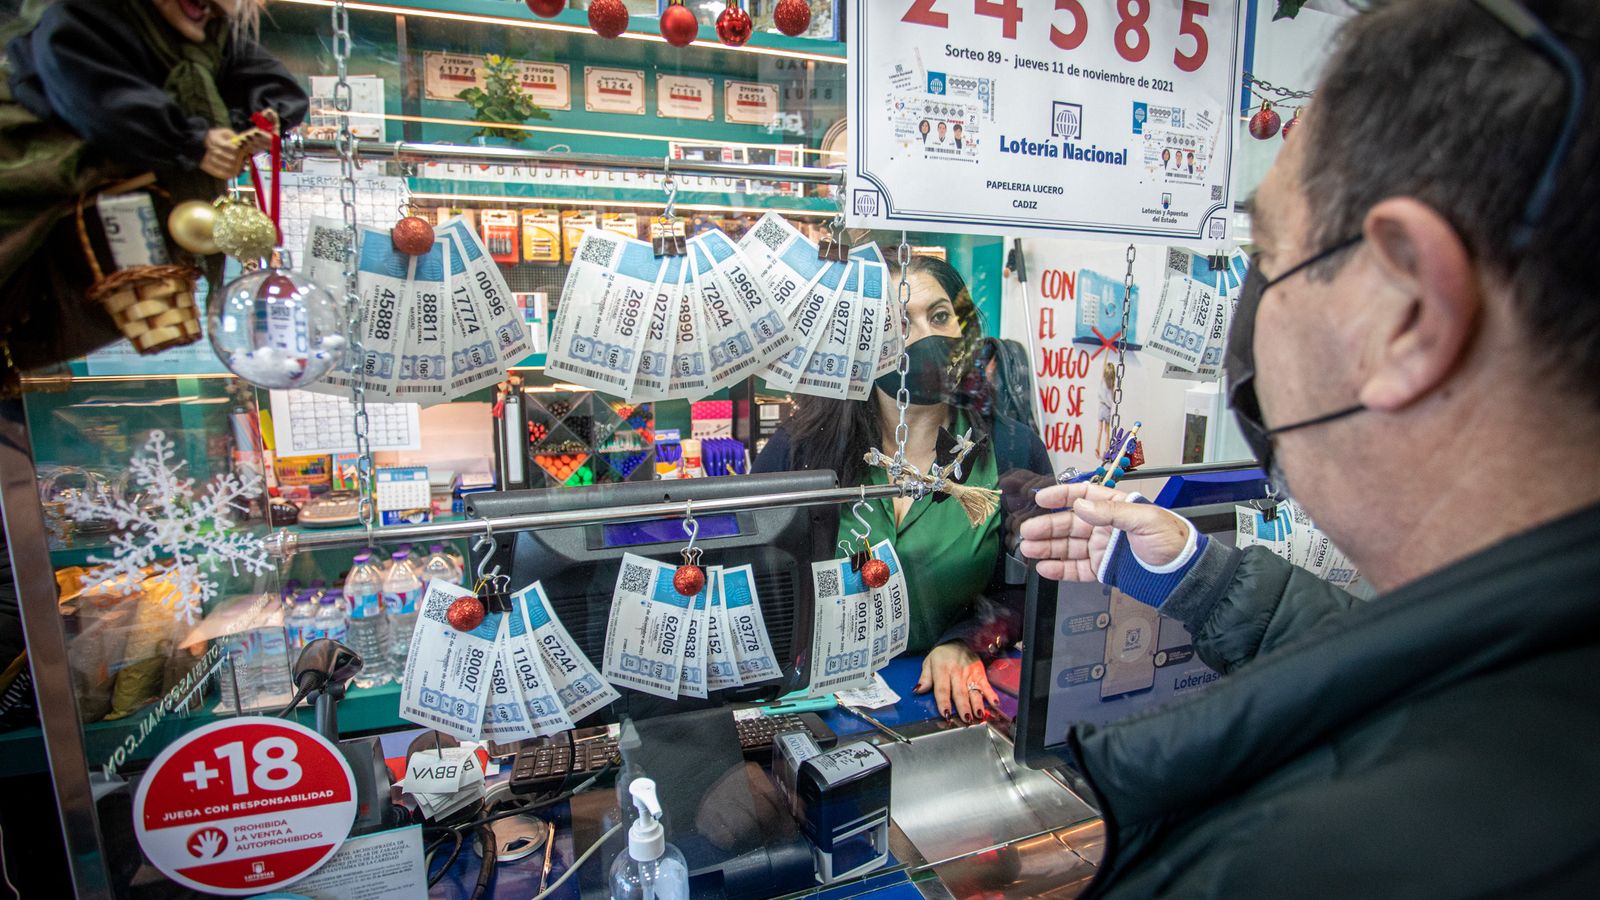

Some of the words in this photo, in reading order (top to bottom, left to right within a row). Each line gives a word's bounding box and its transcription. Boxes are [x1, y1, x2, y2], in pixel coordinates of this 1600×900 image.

[945, 44, 984, 62] Sorteo
[988, 50, 1001, 64] 89
[1014, 54, 1049, 72] jueves
[1052, 62, 1064, 74] 11
[1067, 64, 1080, 76] de
[1082, 68, 1134, 86] noviembre
[1138, 76, 1149, 88] de
[1152, 79, 1174, 92] 2021
[1000, 135, 1058, 158] Lotería
[1063, 142, 1127, 165] Nacional
[653, 172, 732, 187] LCERO
[986, 180, 1030, 192] PAPELERIA
[1033, 184, 1064, 194] LUCERO
[1012, 200, 1038, 209] CADIZ
[476, 270, 505, 316] 00696
[729, 265, 762, 309] 19662
[1041, 270, 1076, 301] CON
[375, 288, 396, 340] 45888
[422, 294, 437, 342] 88811
[453, 286, 480, 335] 17774
[621, 291, 644, 337] 26999
[650, 294, 668, 341] 02732
[704, 281, 733, 328] 72044
[799, 294, 824, 337] 90007
[835, 300, 850, 345] 08777
[1196, 292, 1211, 327] 42322
[1213, 304, 1223, 339] 04256
[859, 308, 874, 351] 24226
[1039, 308, 1055, 340] EL
[1037, 347, 1089, 379] JUEGO
[1067, 384, 1086, 417] SE
[1045, 422, 1083, 454] UEGA
[1316, 538, 1328, 568] 02908
[874, 593, 884, 630] 59992
[891, 584, 902, 620] 10030
[662, 616, 679, 656] 62005
[740, 615, 759, 652] 03778
[858, 602, 866, 641] 00164
[465, 648, 484, 693] 80007
[514, 647, 539, 690] 11043
[544, 634, 576, 672] 67244
[493, 653, 508, 694] 5580
[182, 736, 302, 796] +18
[412, 766, 457, 780] BBVA
[162, 809, 202, 821] JUEGA
[204, 805, 229, 816] CON
[232, 789, 334, 811] RESPONSABILIDAD
[233, 819, 288, 832] PROHIBIDA
[234, 834, 248, 842] LA
[250, 830, 282, 840] VENTA
[236, 832, 323, 852] AUTOPROHIBIDOS
